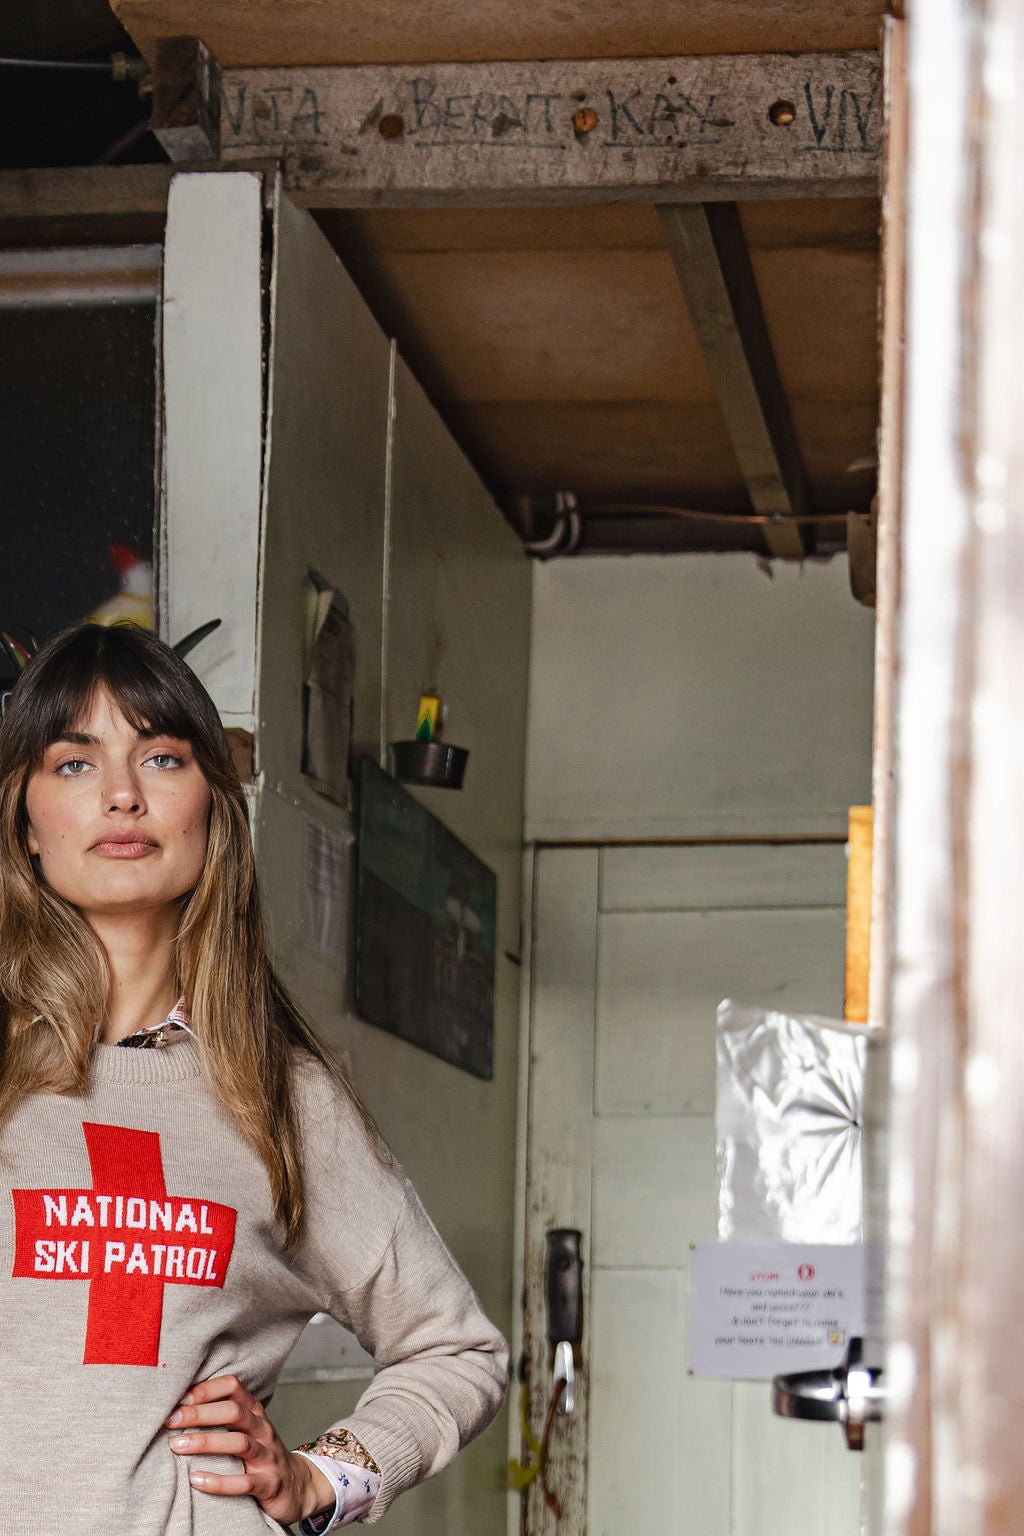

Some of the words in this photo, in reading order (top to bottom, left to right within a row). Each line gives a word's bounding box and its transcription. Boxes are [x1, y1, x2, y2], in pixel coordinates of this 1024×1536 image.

[42, 1194, 214, 1235] NATIONAL
[33, 1239, 90, 1274] SKI
[104, 1240, 218, 1280] PATROL
